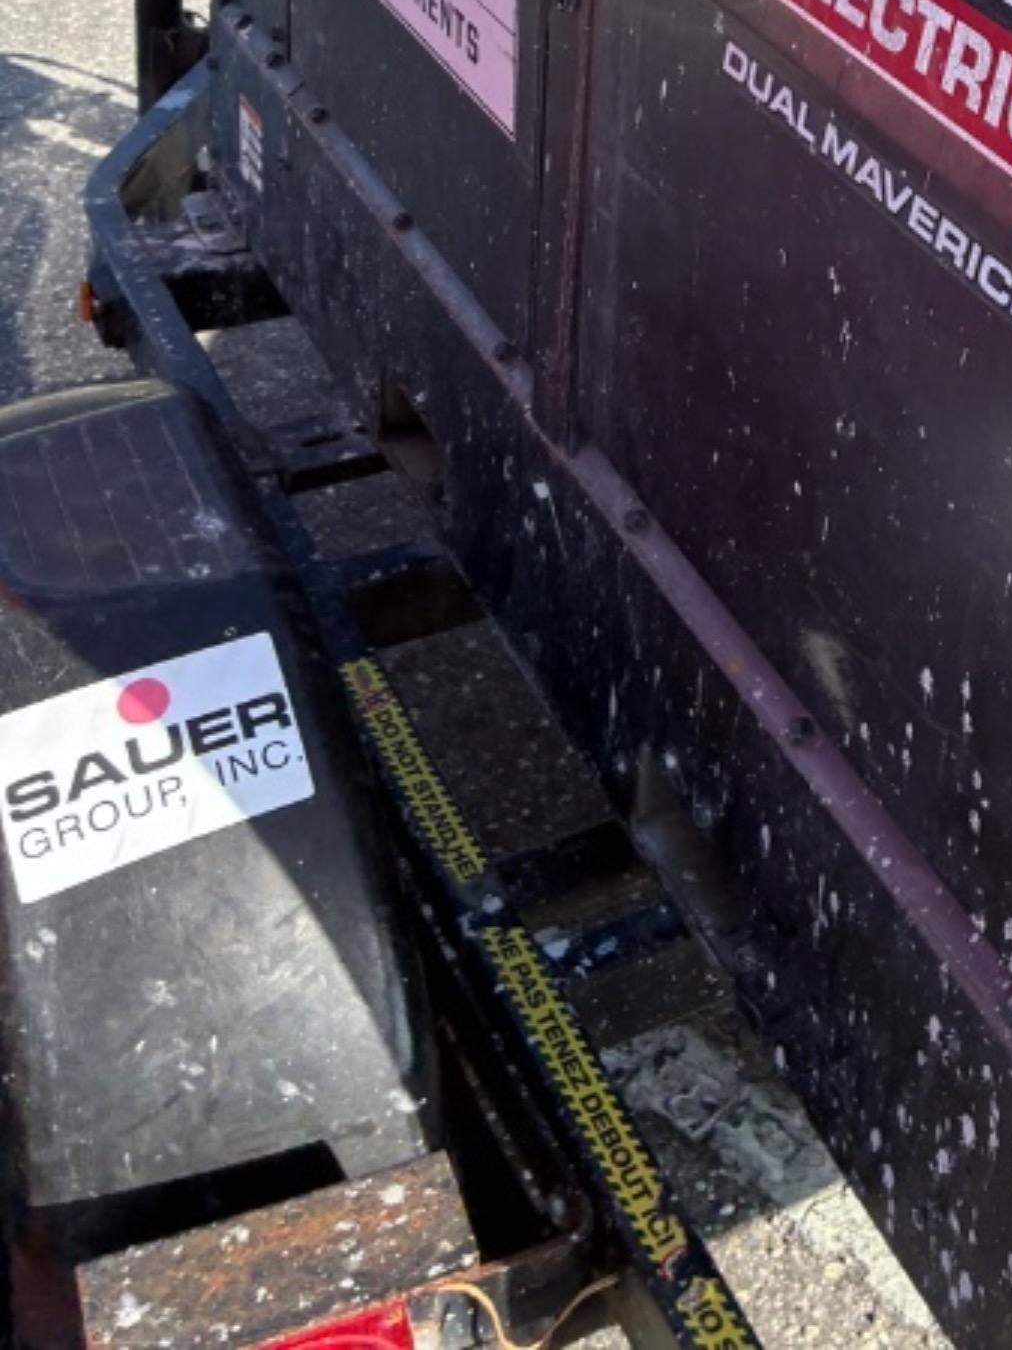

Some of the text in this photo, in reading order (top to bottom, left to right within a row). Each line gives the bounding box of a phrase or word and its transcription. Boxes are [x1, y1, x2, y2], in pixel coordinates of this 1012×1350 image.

[721, 40, 816, 144] DUAL
[5, 692, 292, 822] SAUER
[19, 740, 304, 859] GROUP, INC.
[374, 707, 399, 739] DO
[391, 739, 423, 776] NOT
[412, 778, 460, 849] STAND
[513, 962, 547, 1010] PAS
[536, 1012, 591, 1092] TENEZ
[580, 1092, 653, 1202] DEBOUT
